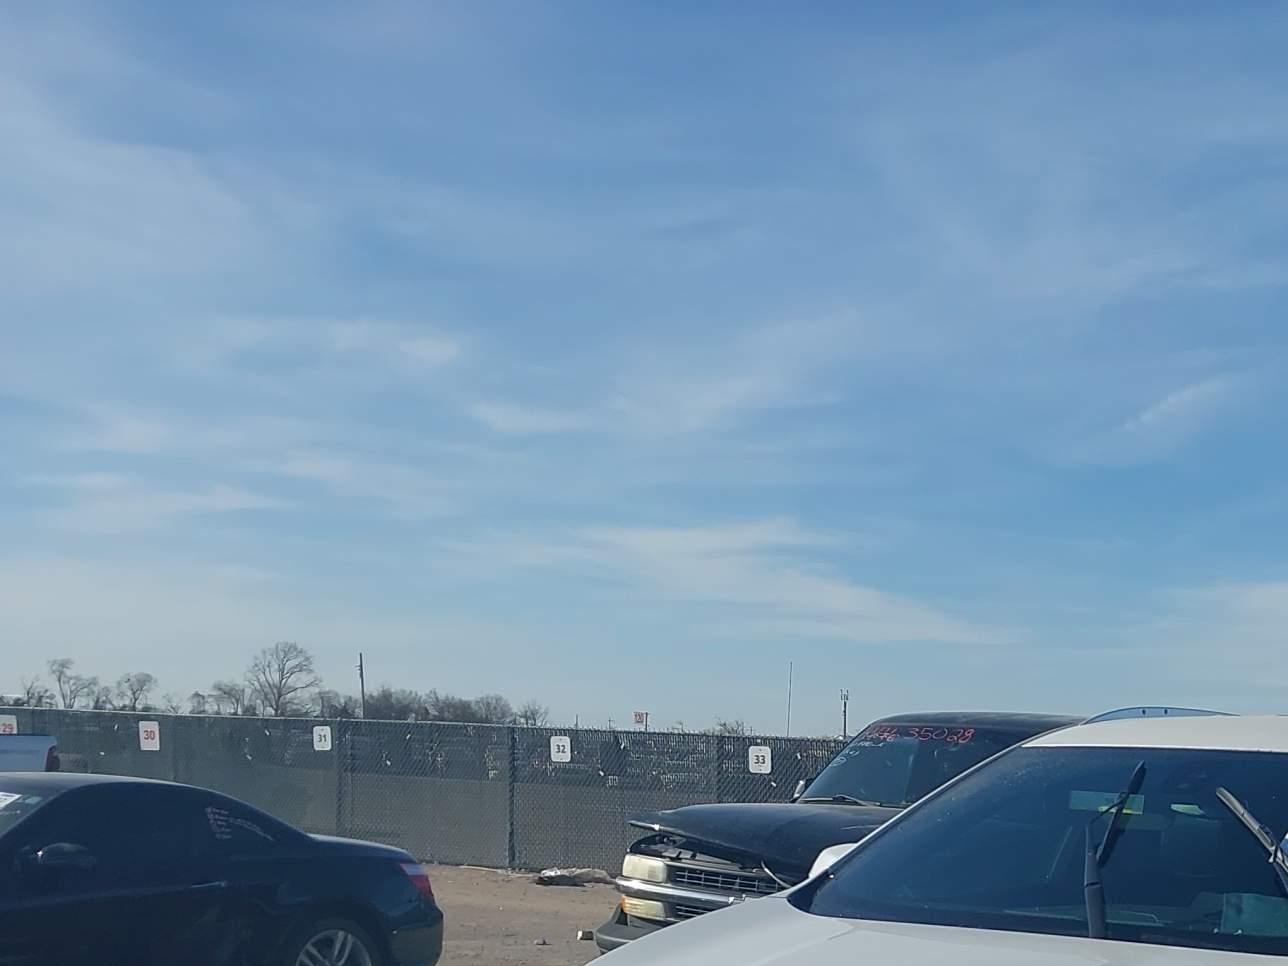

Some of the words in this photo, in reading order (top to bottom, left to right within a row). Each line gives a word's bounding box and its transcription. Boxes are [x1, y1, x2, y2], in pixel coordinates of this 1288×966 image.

[2, 723, 14, 734] 29
[143, 729, 156, 741] 30
[317, 733, 327, 743] 31
[554, 743, 567, 754] 32
[753, 754, 766, 765] 33
